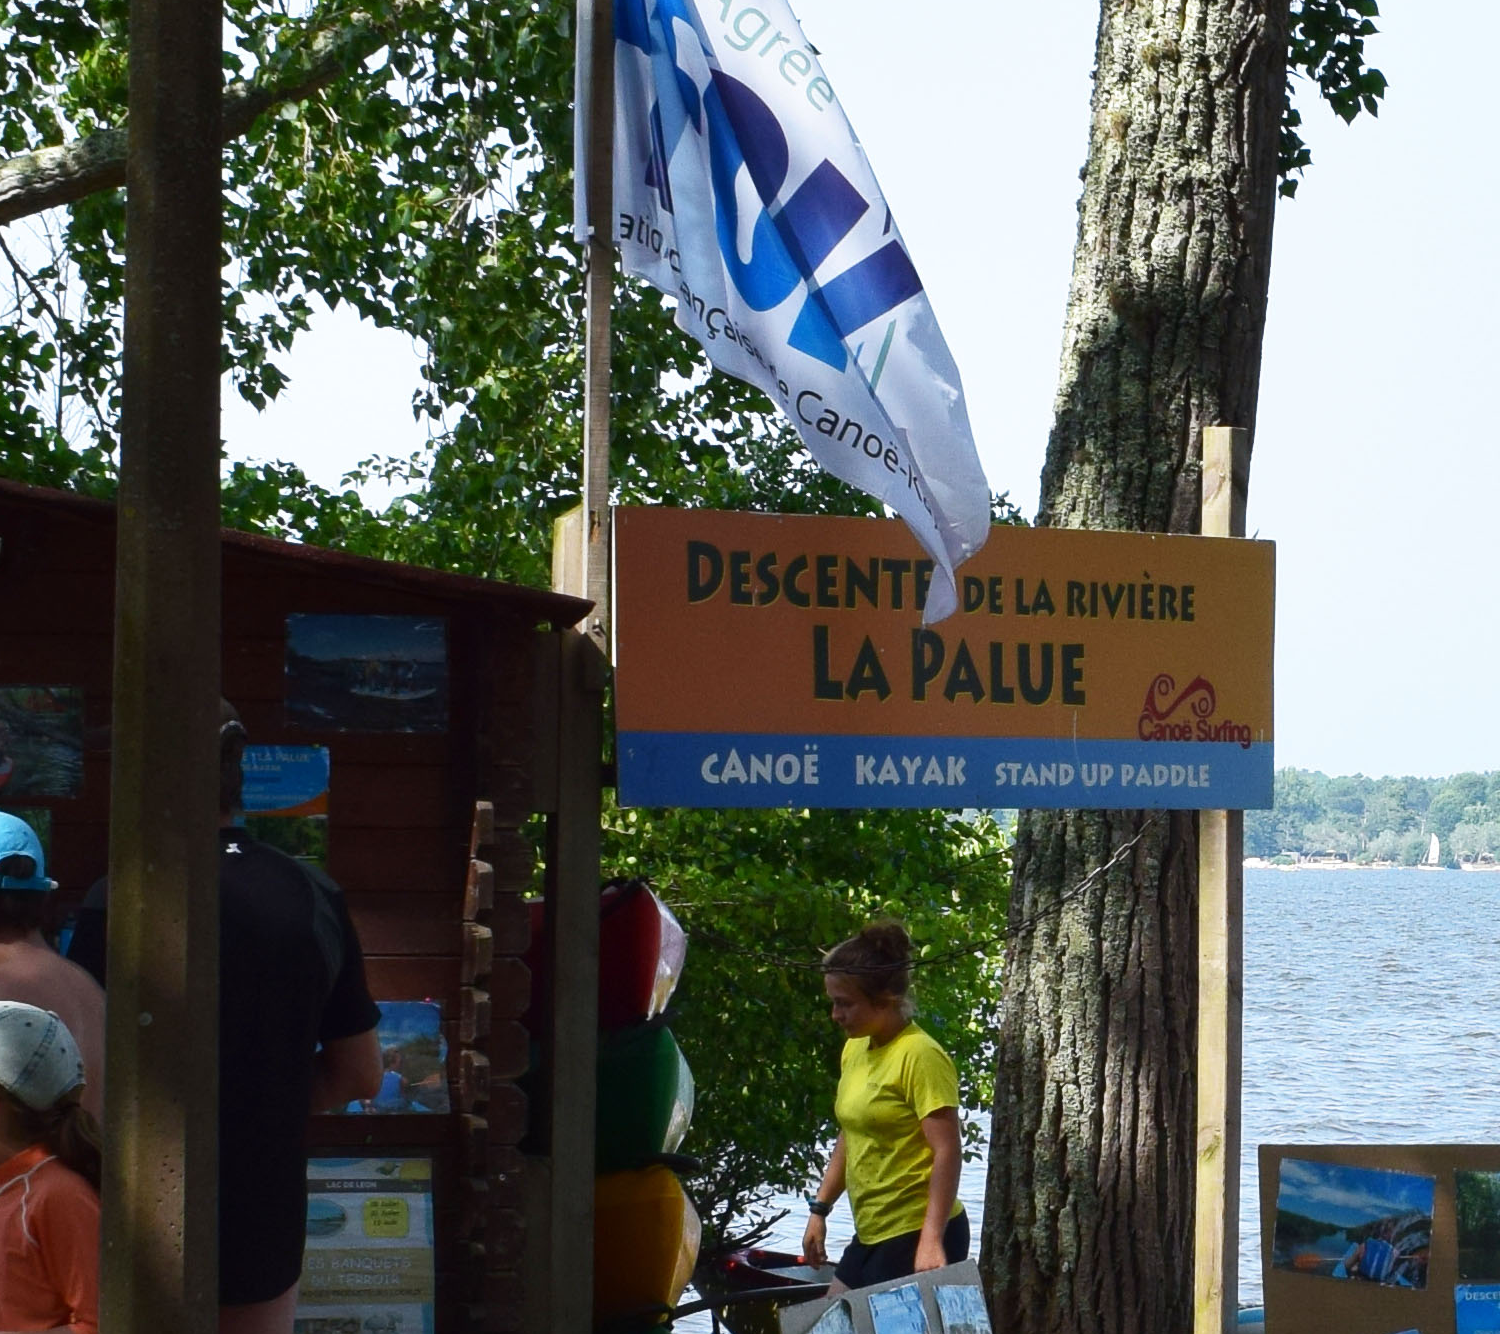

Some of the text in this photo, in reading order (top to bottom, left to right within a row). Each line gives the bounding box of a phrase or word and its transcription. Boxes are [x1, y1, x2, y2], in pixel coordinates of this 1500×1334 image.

[687, 540, 1196, 622] DESCENTE DE LA RIVIÈRE
[813, 625, 1086, 705] LA PALUE
[1138, 713, 1251, 749] Canoë Surfing
[701, 743, 1210, 788] CANOË KAYAK STAND UP PADDLE
